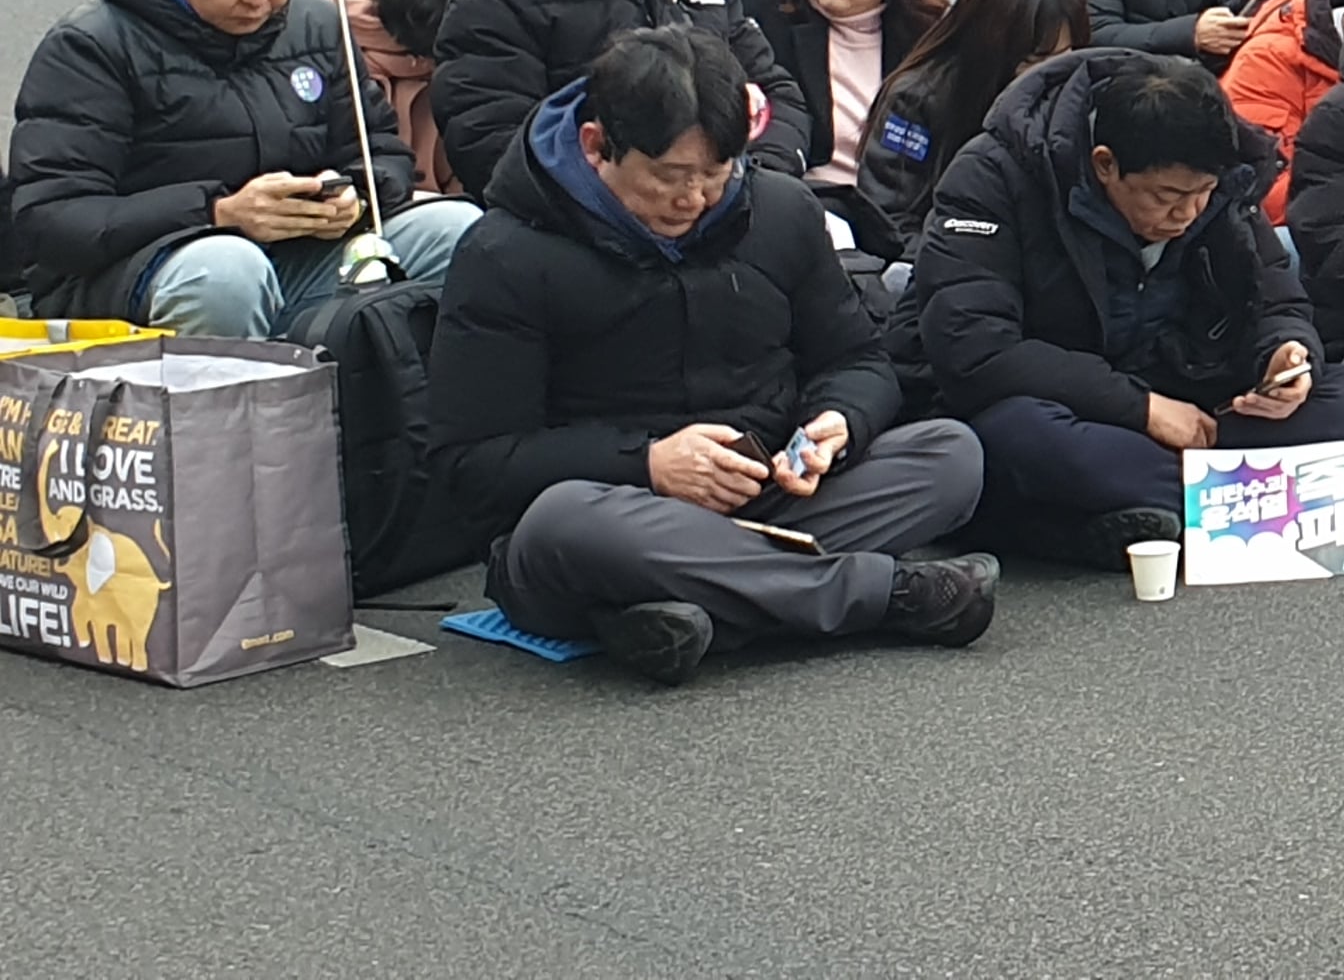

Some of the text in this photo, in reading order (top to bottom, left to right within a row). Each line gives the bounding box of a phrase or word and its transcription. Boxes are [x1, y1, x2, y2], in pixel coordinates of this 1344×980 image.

[88, 416, 158, 446] REAT.
[49, 477, 86, 504] AND
[89, 485, 164, 513] GRASS.
[1199, 473, 1289, 507] 내란수괴
[1201, 491, 1289, 533] 윤석열
[0, 549, 51, 577] ATURE!
[15, 577, 39, 593] OUR
[41, 582, 68, 600] WILD
